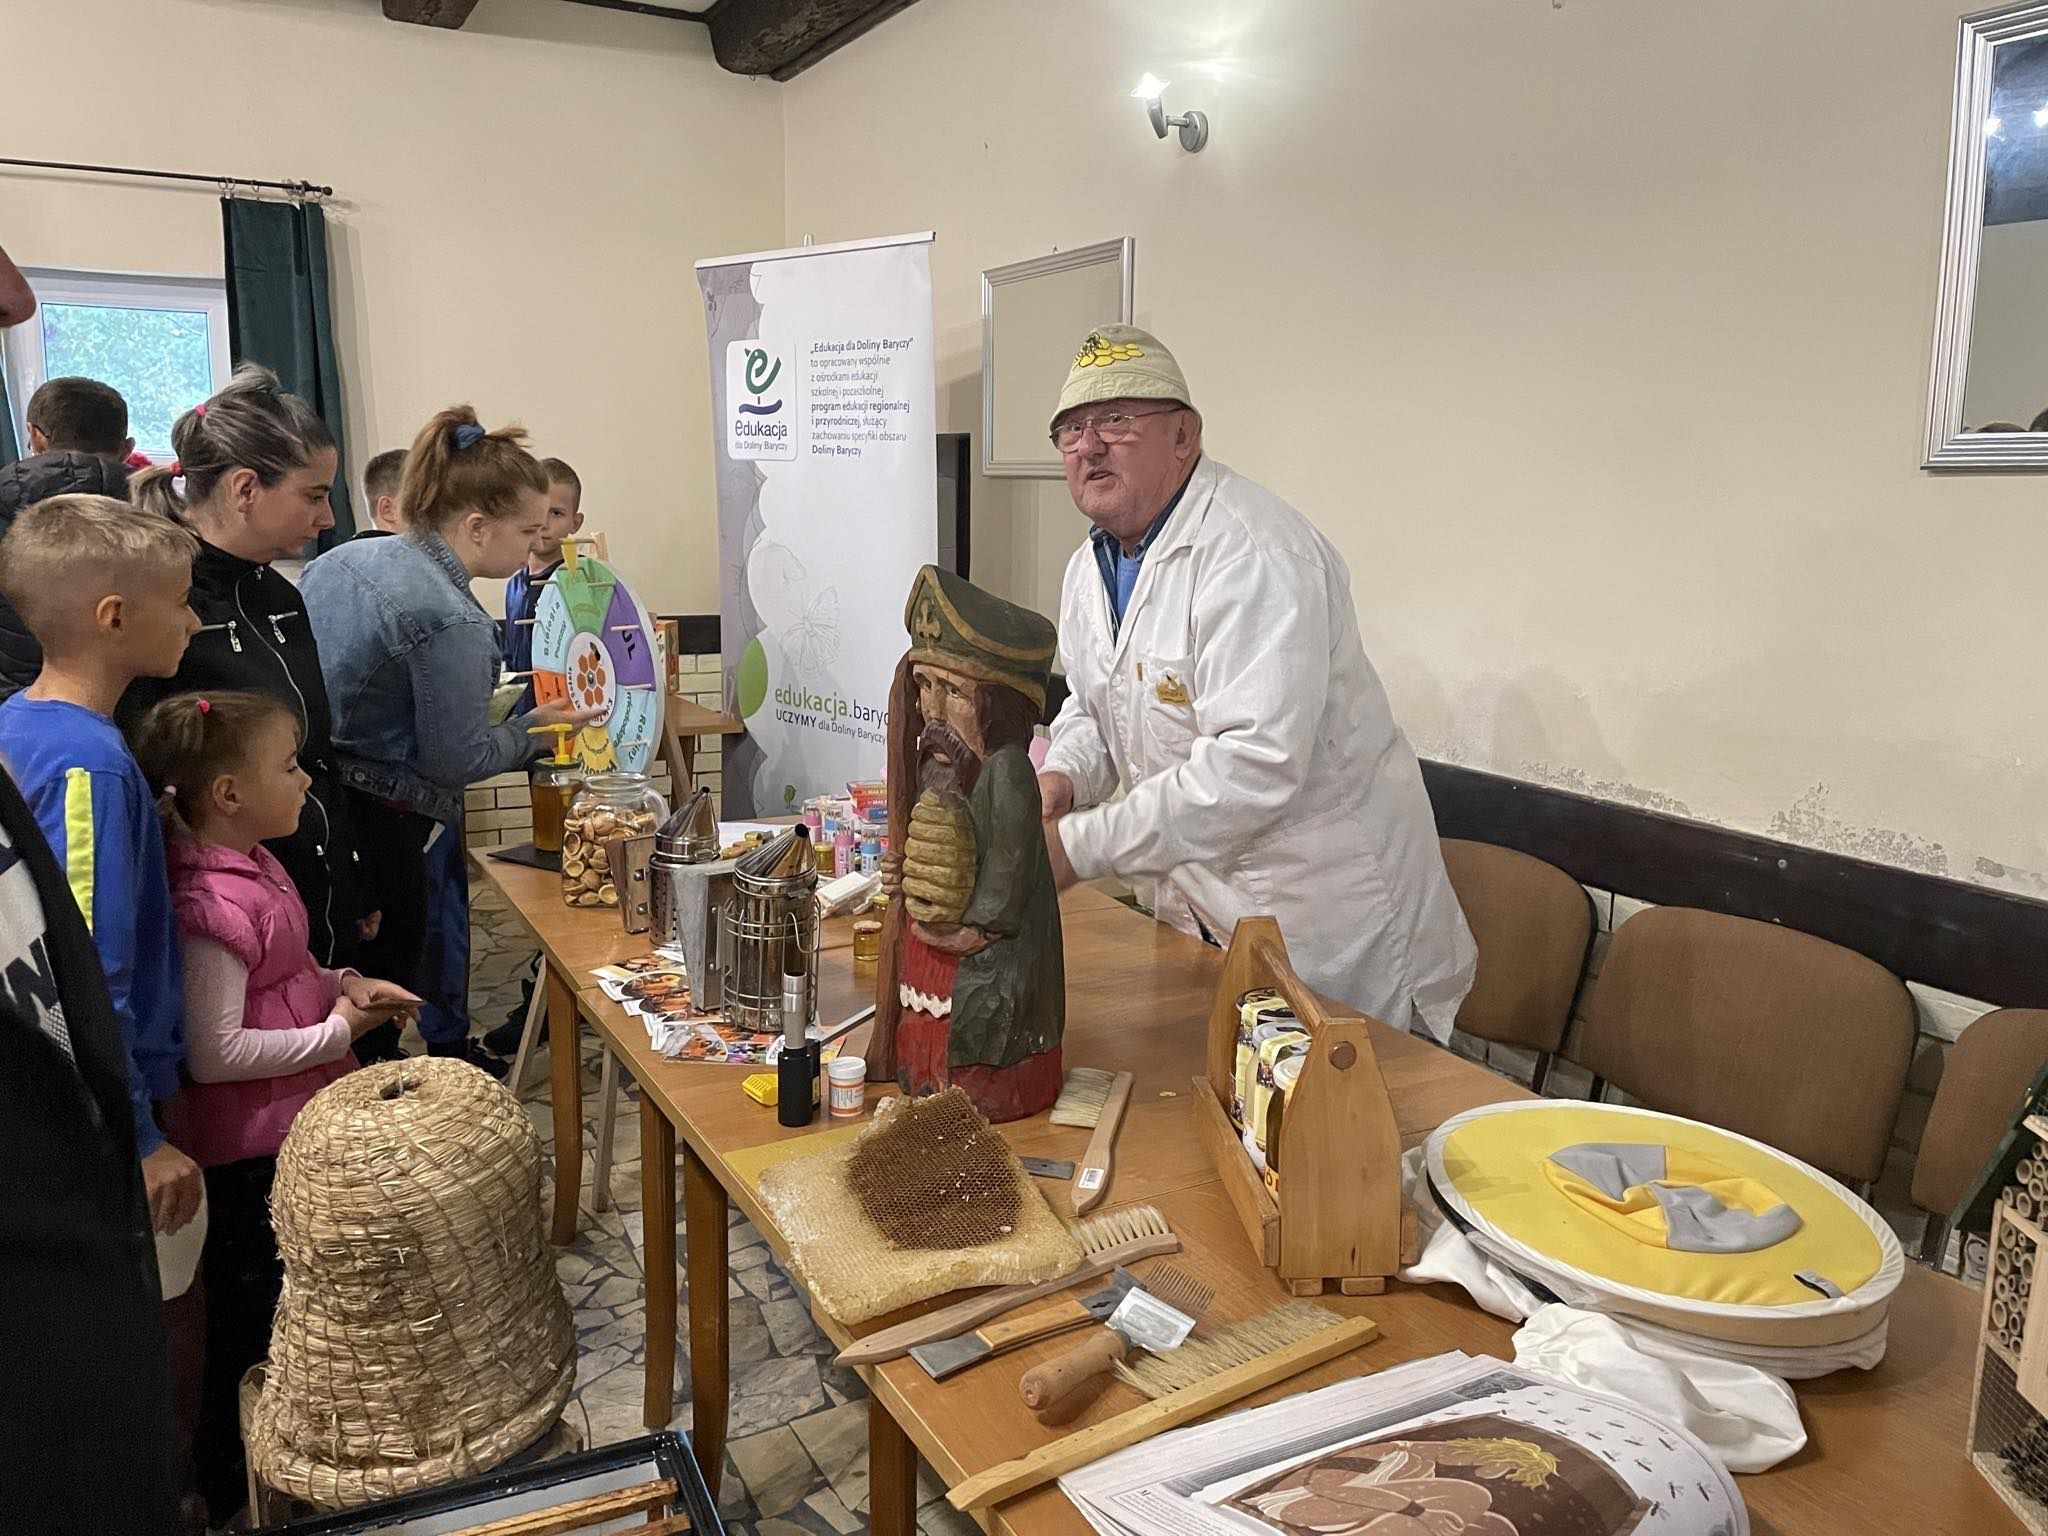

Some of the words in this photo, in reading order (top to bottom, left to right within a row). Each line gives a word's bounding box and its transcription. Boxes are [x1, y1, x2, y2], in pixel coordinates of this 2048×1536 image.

[846, 340, 856, 351] dla
[856, 339, 880, 352] Doliny
[810, 358, 818, 368] to
[820, 359, 857, 368] opracowany
[851, 370, 878, 383] edukacji
[811, 387, 838, 399] szkolnej
[842, 384, 884, 398] pozaszkolnej
[812, 403, 842, 414] program
[842, 400, 868, 413] edukacji
[870, 400, 910, 414] regionalnej
[735, 420, 788, 440] edukacja
[879, 432, 906, 441] obszaru
[744, 440, 762, 452] Doliny
[764, 441, 788, 452] Baryczy
[812, 444, 835, 456] Doliny
[836, 445, 862, 458] Baryczy
[776, 708, 816, 728] UCZYMY
[818, 721, 830, 731] dla
[832, 722, 856, 738] Doliny
[858, 728, 886, 745] Baryczy
